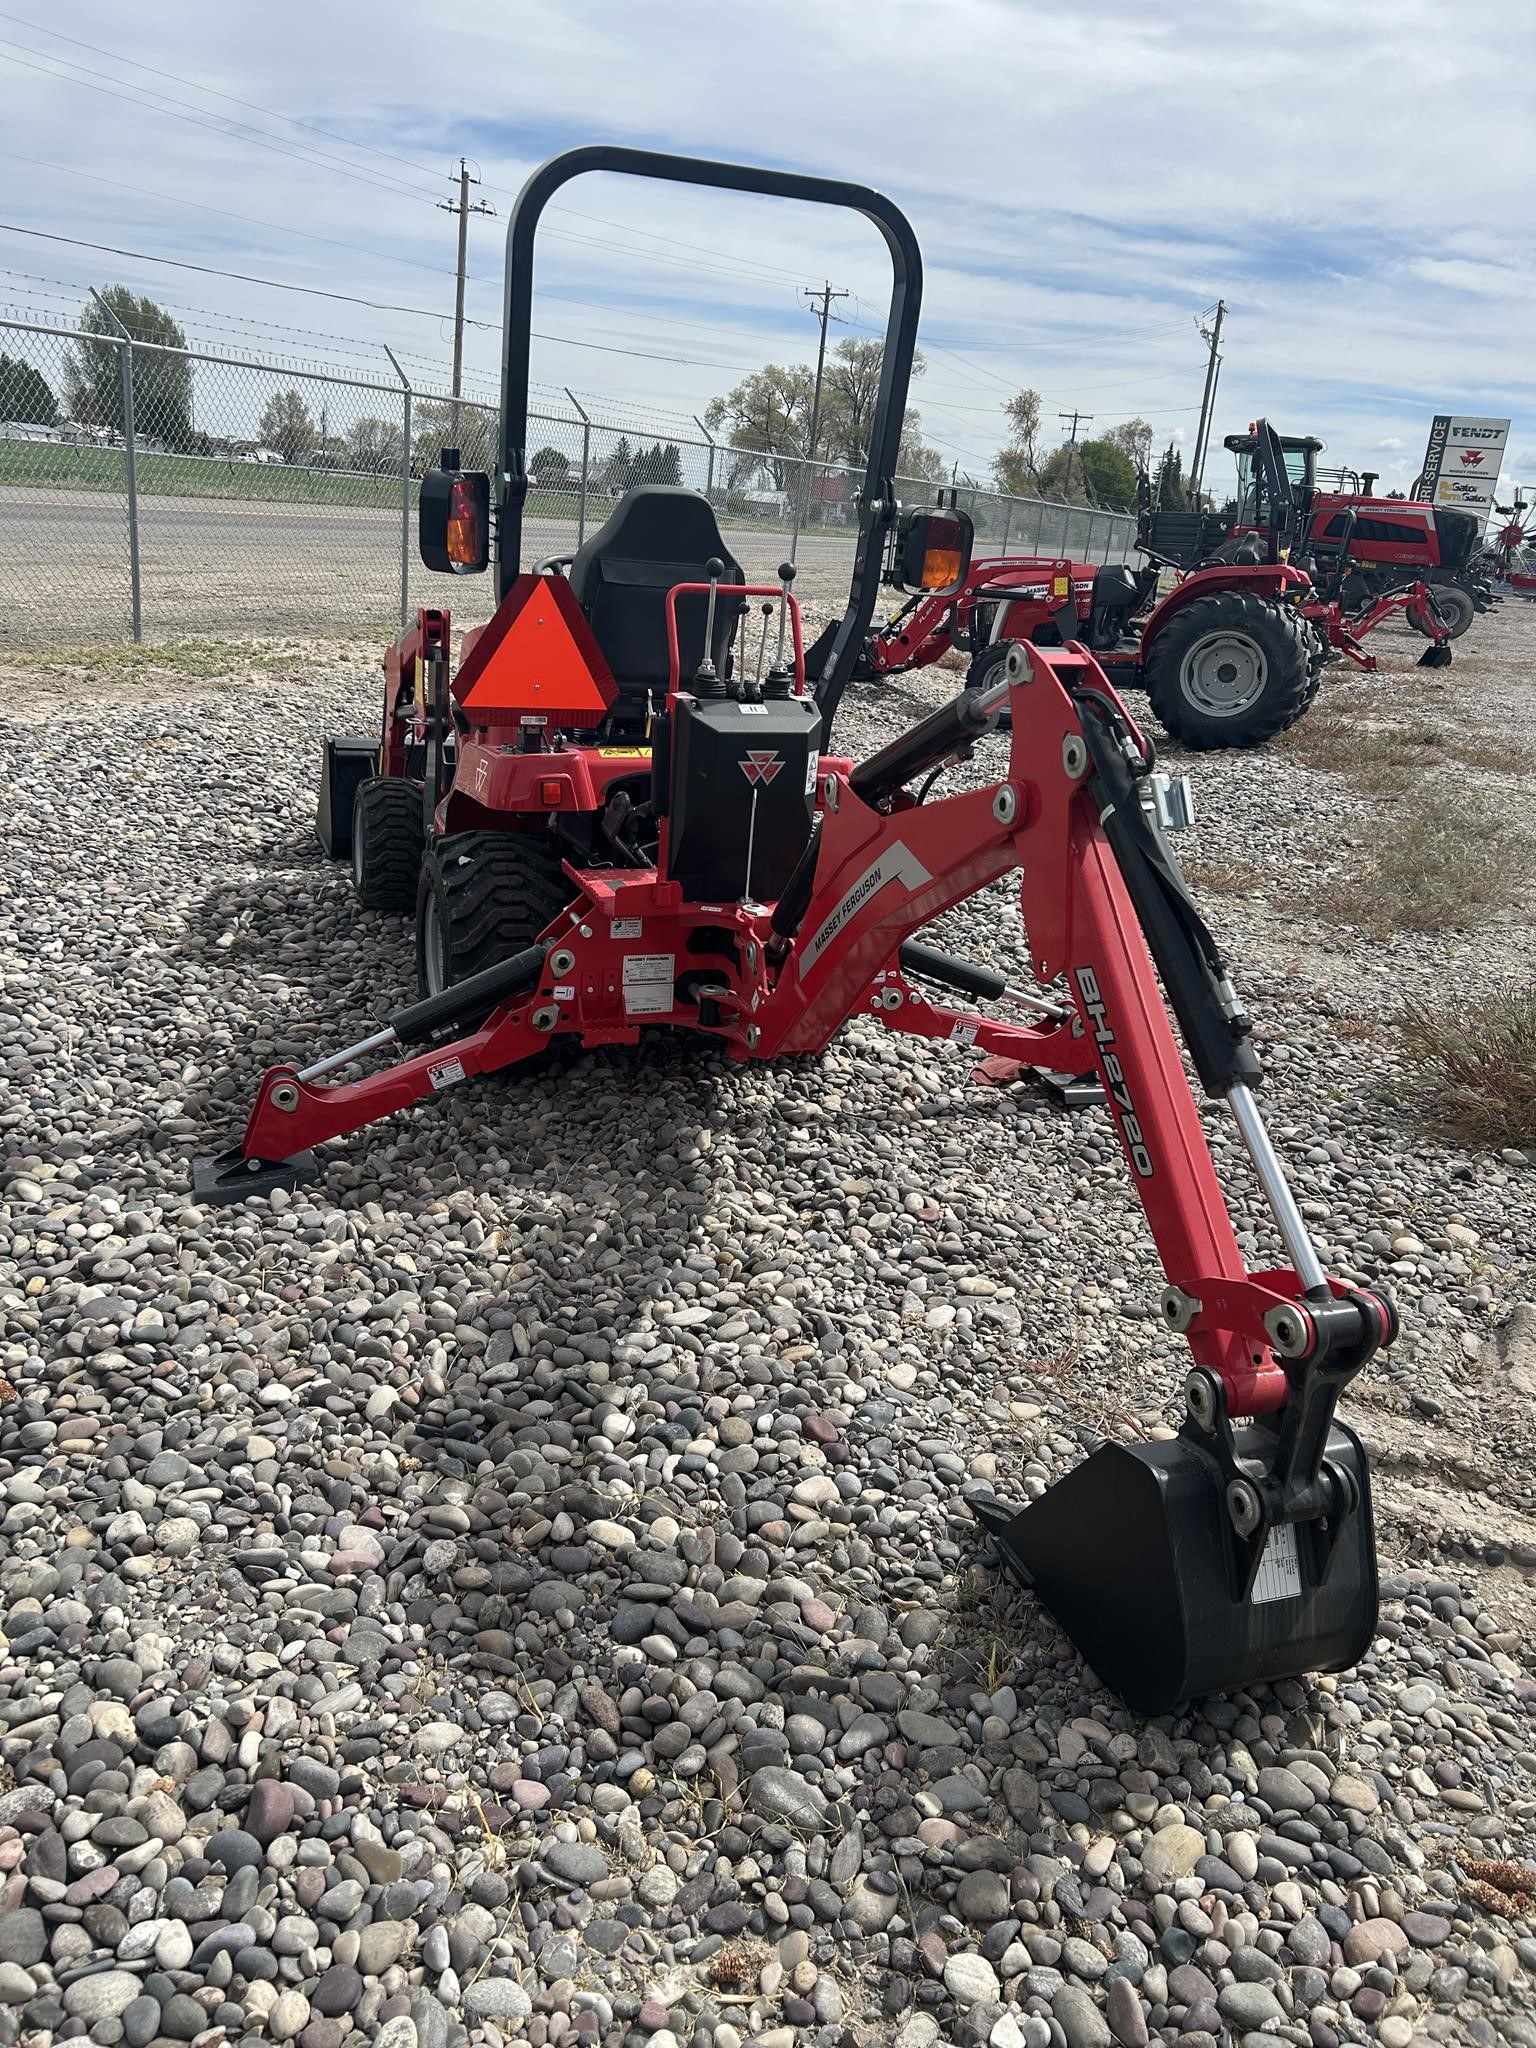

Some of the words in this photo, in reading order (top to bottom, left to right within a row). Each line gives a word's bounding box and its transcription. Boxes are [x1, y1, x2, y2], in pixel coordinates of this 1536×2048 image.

[1452, 427, 1505, 439] FENDT
[1027, 586, 1049, 594] MASSE
[814, 913, 841, 952] MASSEY
[841, 867, 882, 918] FERGUSON
[1074, 966, 1154, 1178] BH-2720
